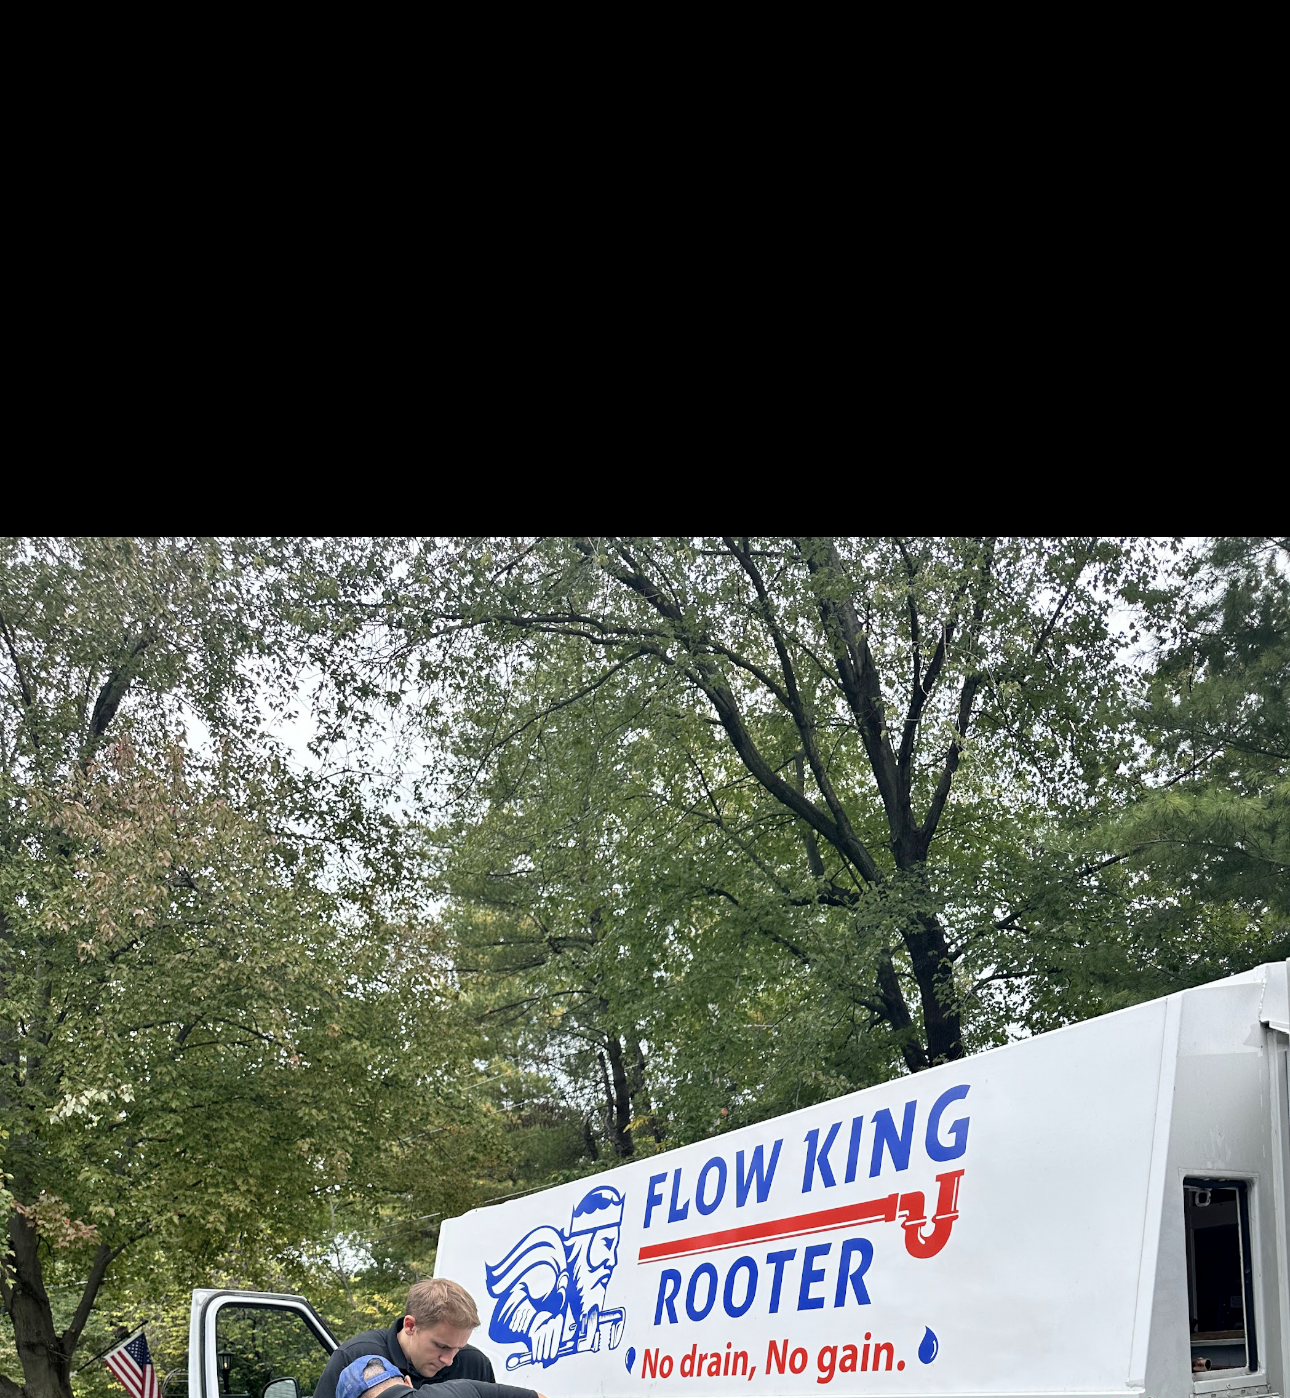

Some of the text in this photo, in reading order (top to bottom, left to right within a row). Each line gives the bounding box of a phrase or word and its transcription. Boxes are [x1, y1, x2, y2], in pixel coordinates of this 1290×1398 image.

[644, 1085, 971, 1229] FLOW KING
[654, 1238, 874, 1326] ROOTER
[641, 1331, 906, 1384] No drain, No gain.
